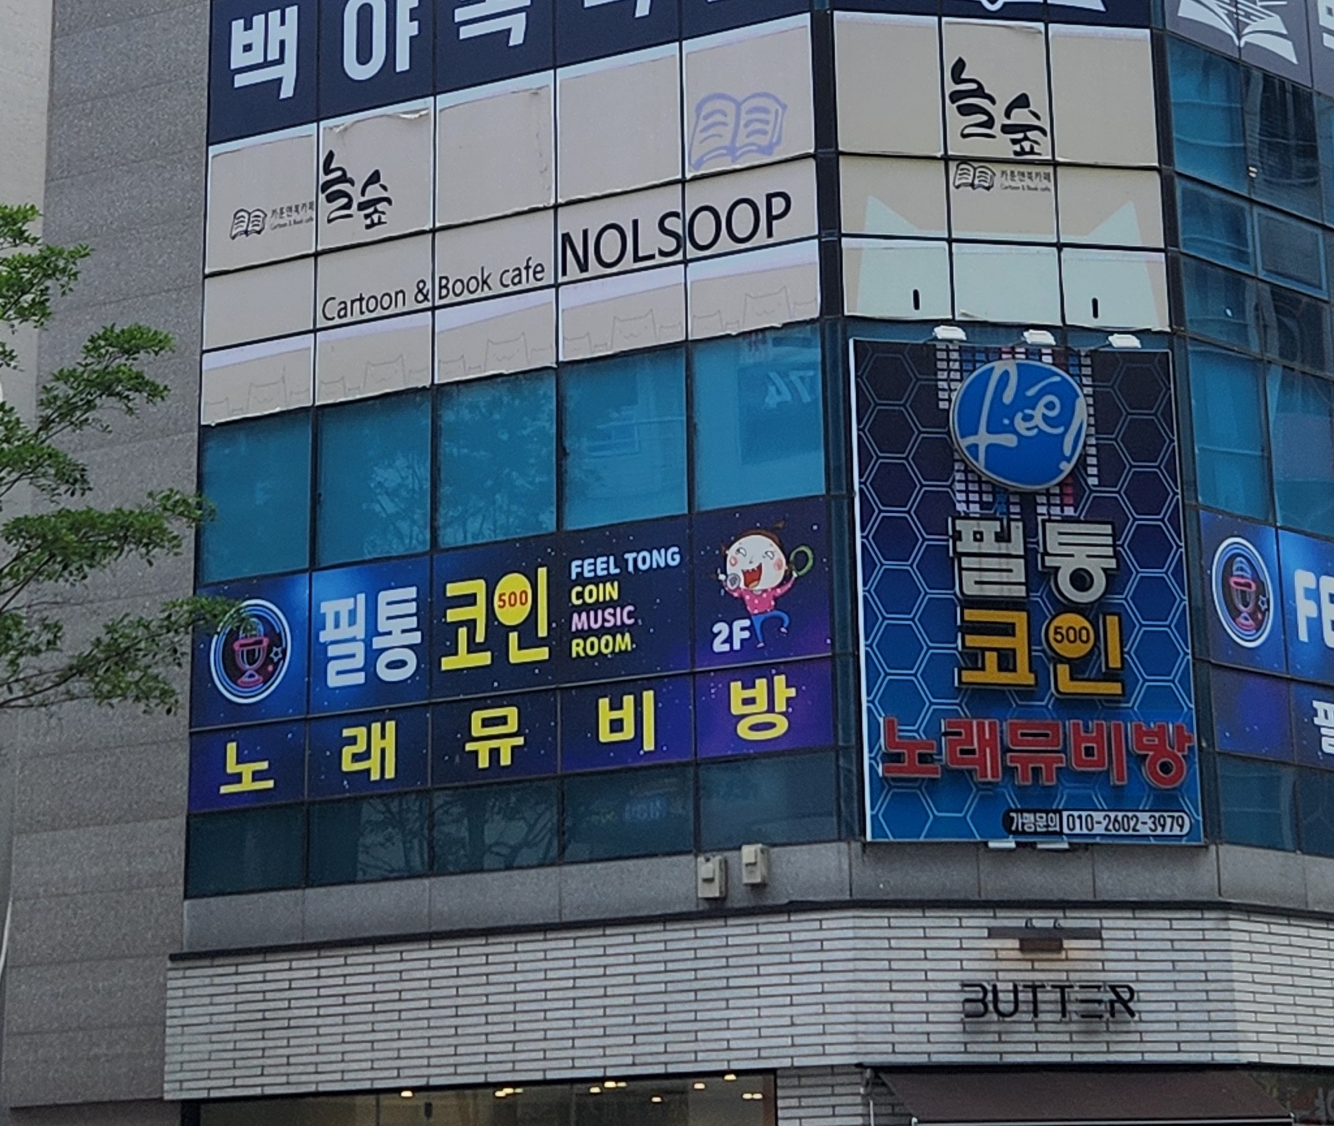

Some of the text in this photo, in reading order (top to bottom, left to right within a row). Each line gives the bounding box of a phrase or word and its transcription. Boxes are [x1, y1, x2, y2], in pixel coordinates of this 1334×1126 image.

[560, 190, 792, 277] NOLSOOP
[322, 257, 546, 321] Cartoon & Book cafe
[570, 546, 682, 580] FEEL TONG
[953, 518, 1118, 605] 필통
[497, 588, 531, 610] 500
[570, 580, 619, 606] COIN
[318, 567, 551, 689] 필통 코인
[570, 605, 636, 632] MUSIC
[712, 618, 752, 653] 2F
[1052, 625, 1091, 645] 500
[571, 631, 632, 658] ROOM
[959, 607, 1126, 697] 코인
[880, 716, 1195, 788] 노래뮤비방
[1008, 811, 1186, 834] 가맹문의 010-2602-3979
[960, 982, 1138, 1021] BUTTER
